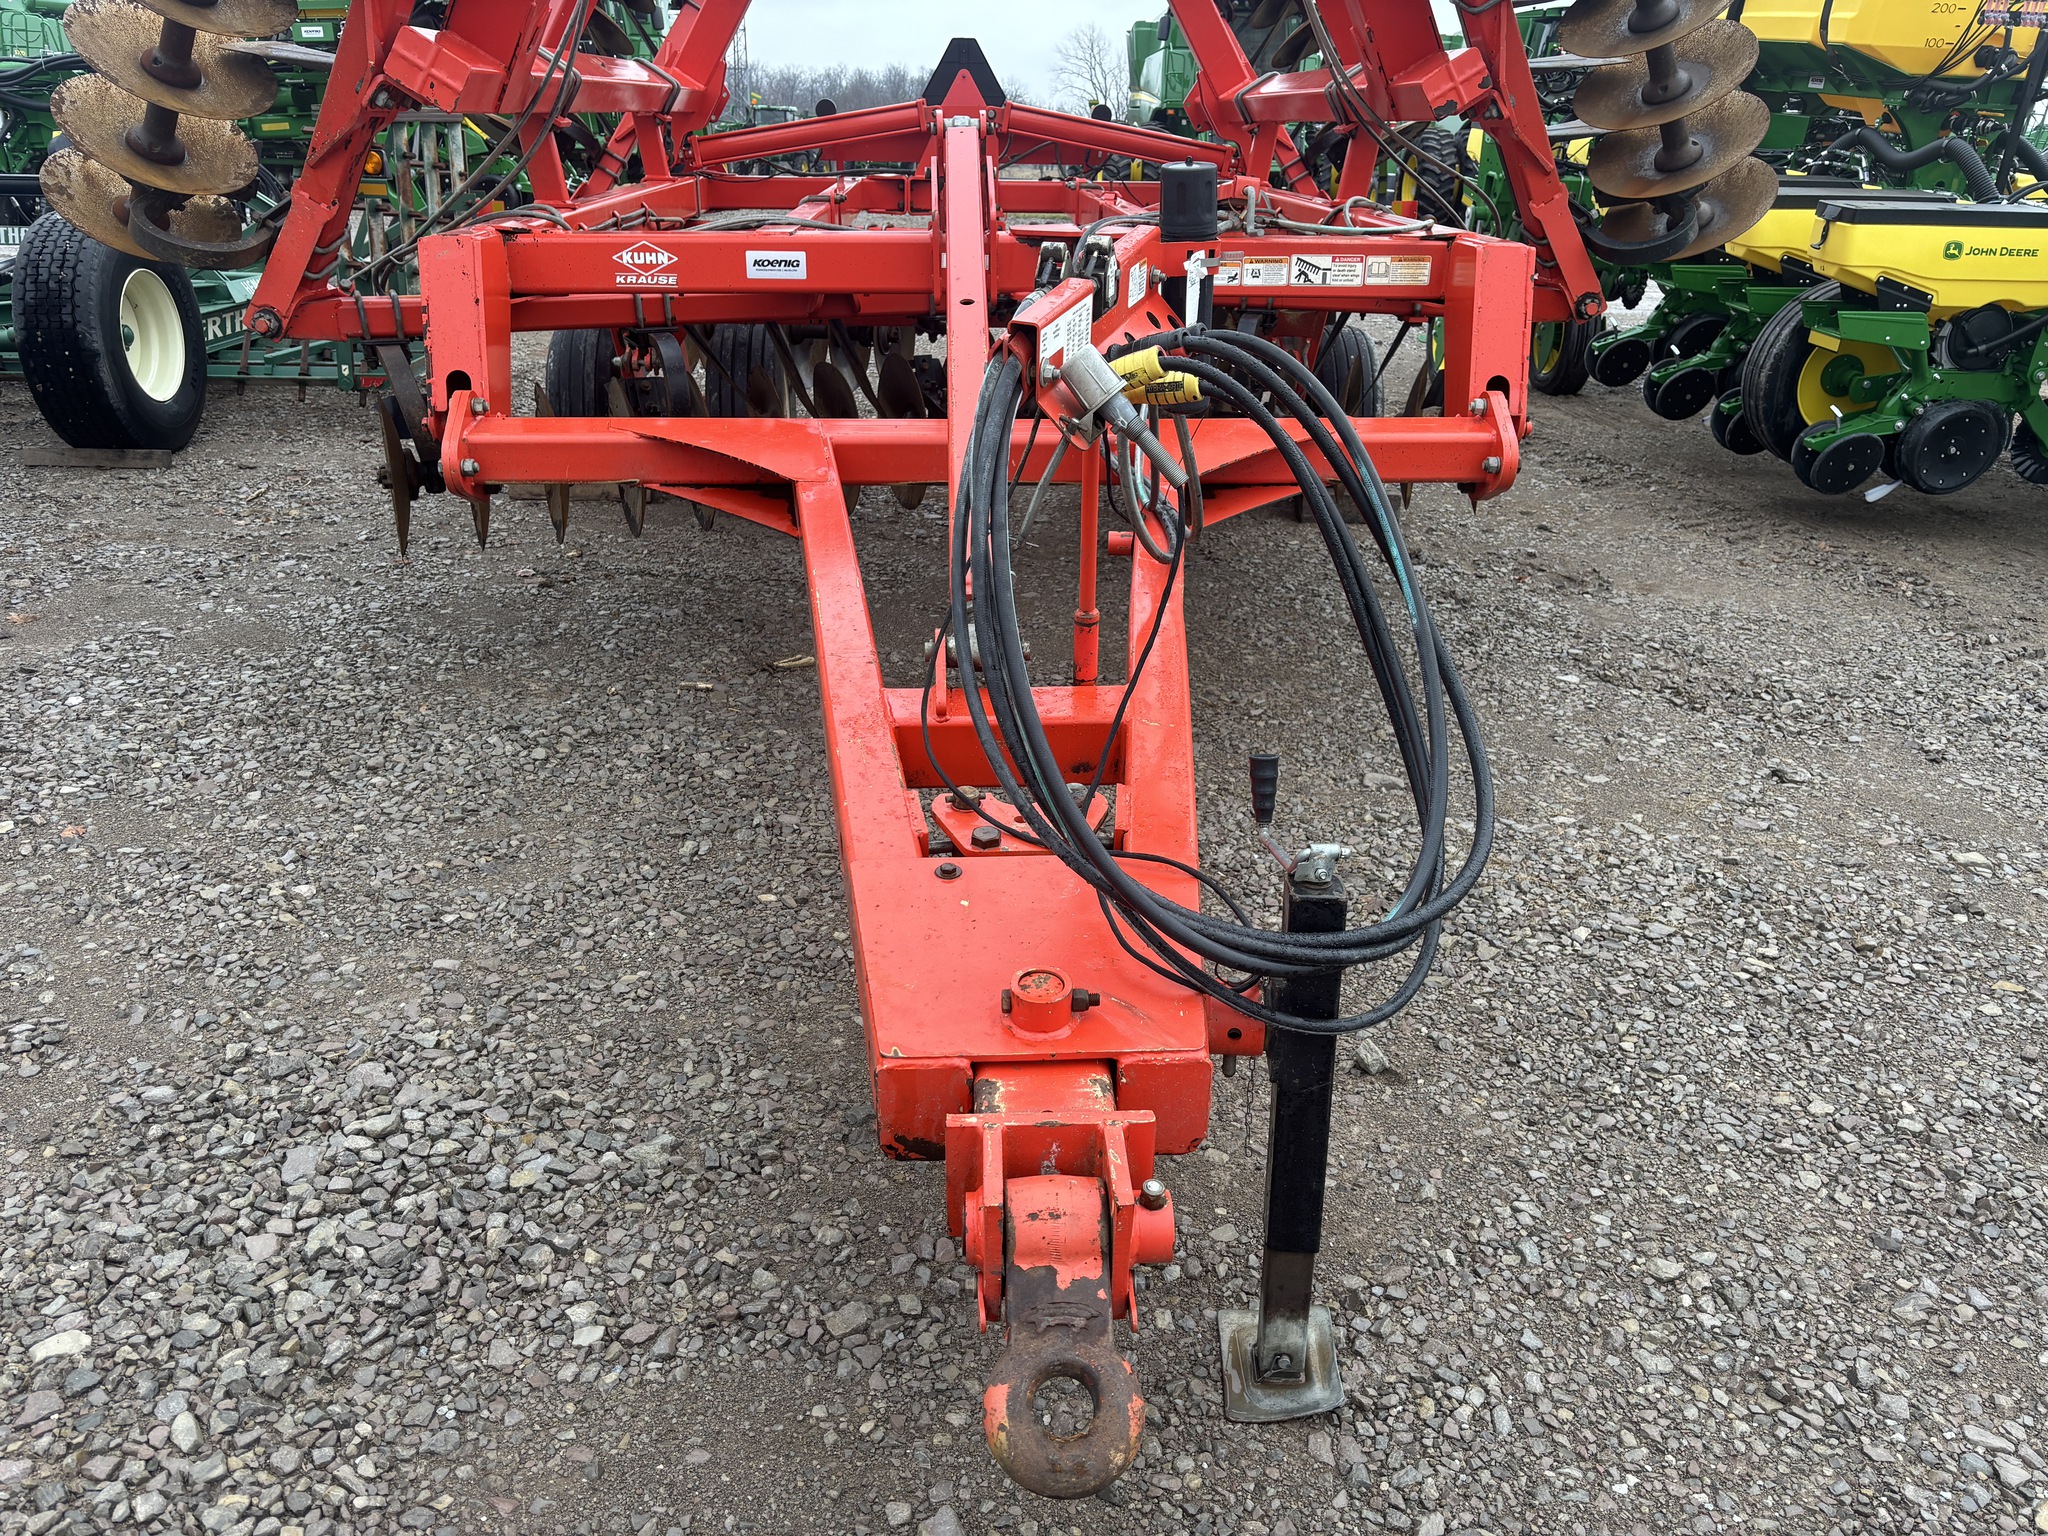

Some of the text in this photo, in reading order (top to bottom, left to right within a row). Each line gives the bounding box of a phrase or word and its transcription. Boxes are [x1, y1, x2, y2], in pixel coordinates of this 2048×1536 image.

[1931, 3, 1957, 14] 200
[1924, 38, 1945, 48] 100
[1965, 246, 2040, 257] JOHN DEERE
[622, 251, 670, 266] KUHN
[615, 275, 678, 285] KRAUSE
